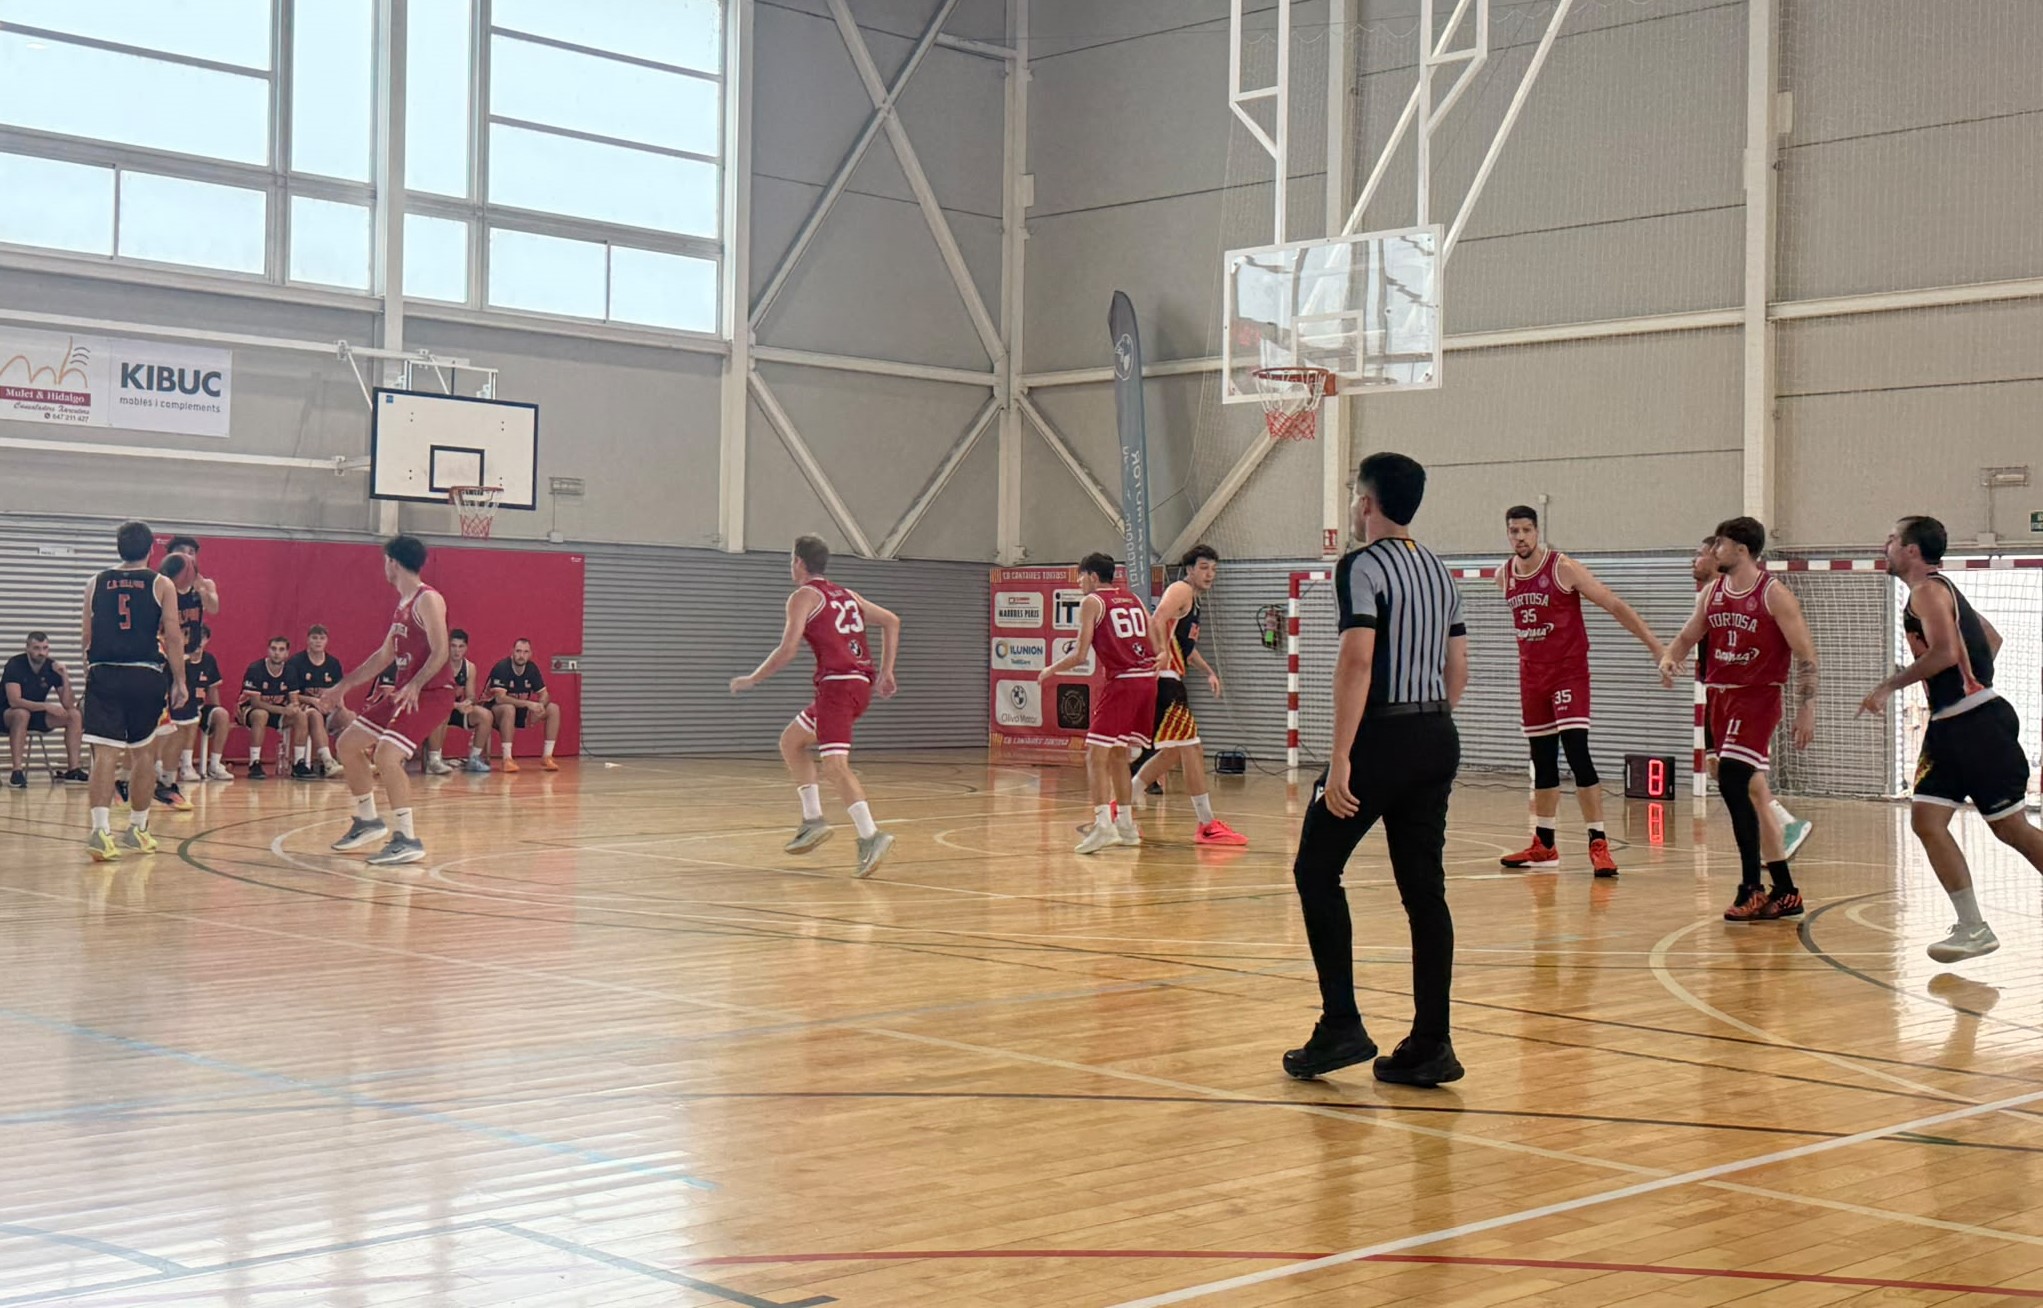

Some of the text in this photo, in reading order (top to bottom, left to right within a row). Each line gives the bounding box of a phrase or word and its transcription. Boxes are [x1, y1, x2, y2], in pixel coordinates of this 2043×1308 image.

[120, 362, 222, 398] KIBUC
[5, 388, 85, 404] Mulet & Hidalgo
[119, 396, 153, 407] mobles
[160, 400, 221, 413] complements
[118, 593, 132, 630] 5
[830, 599, 865, 634] 23
[1520, 608, 1537, 624] 35
[1110, 607, 1147, 639] 60
[1708, 612, 1758, 633] TORTOSA
[1727, 630, 1737, 647] 11
[1010, 645, 1043, 656] ILUNION
[1554, 688, 1572, 705] 35
[1726, 718, 1742, 736] 11
[1648, 759, 1664, 796] 8
